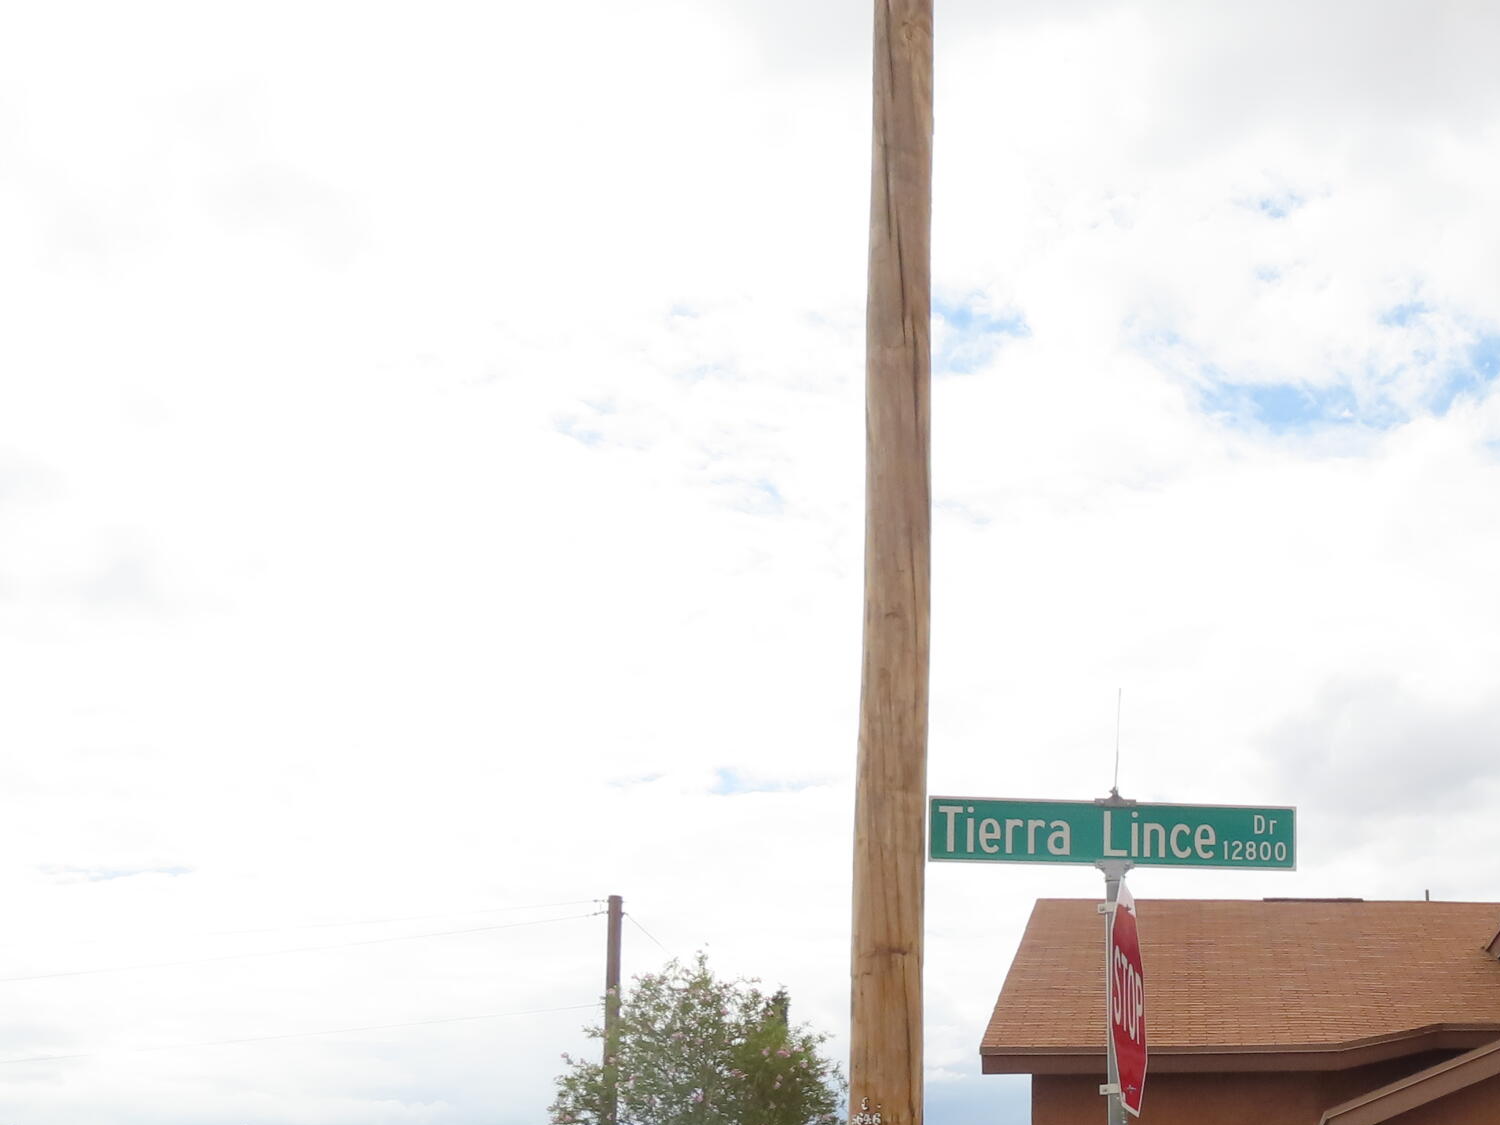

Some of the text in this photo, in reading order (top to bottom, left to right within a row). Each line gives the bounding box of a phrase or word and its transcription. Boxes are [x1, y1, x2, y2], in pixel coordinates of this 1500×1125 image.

[938, 805, 1217, 859] Tierra Lince
[1253, 814, 1277, 835] Dr
[1222, 840, 1287, 862] 12800
[1113, 944, 1143, 1045] STOP
